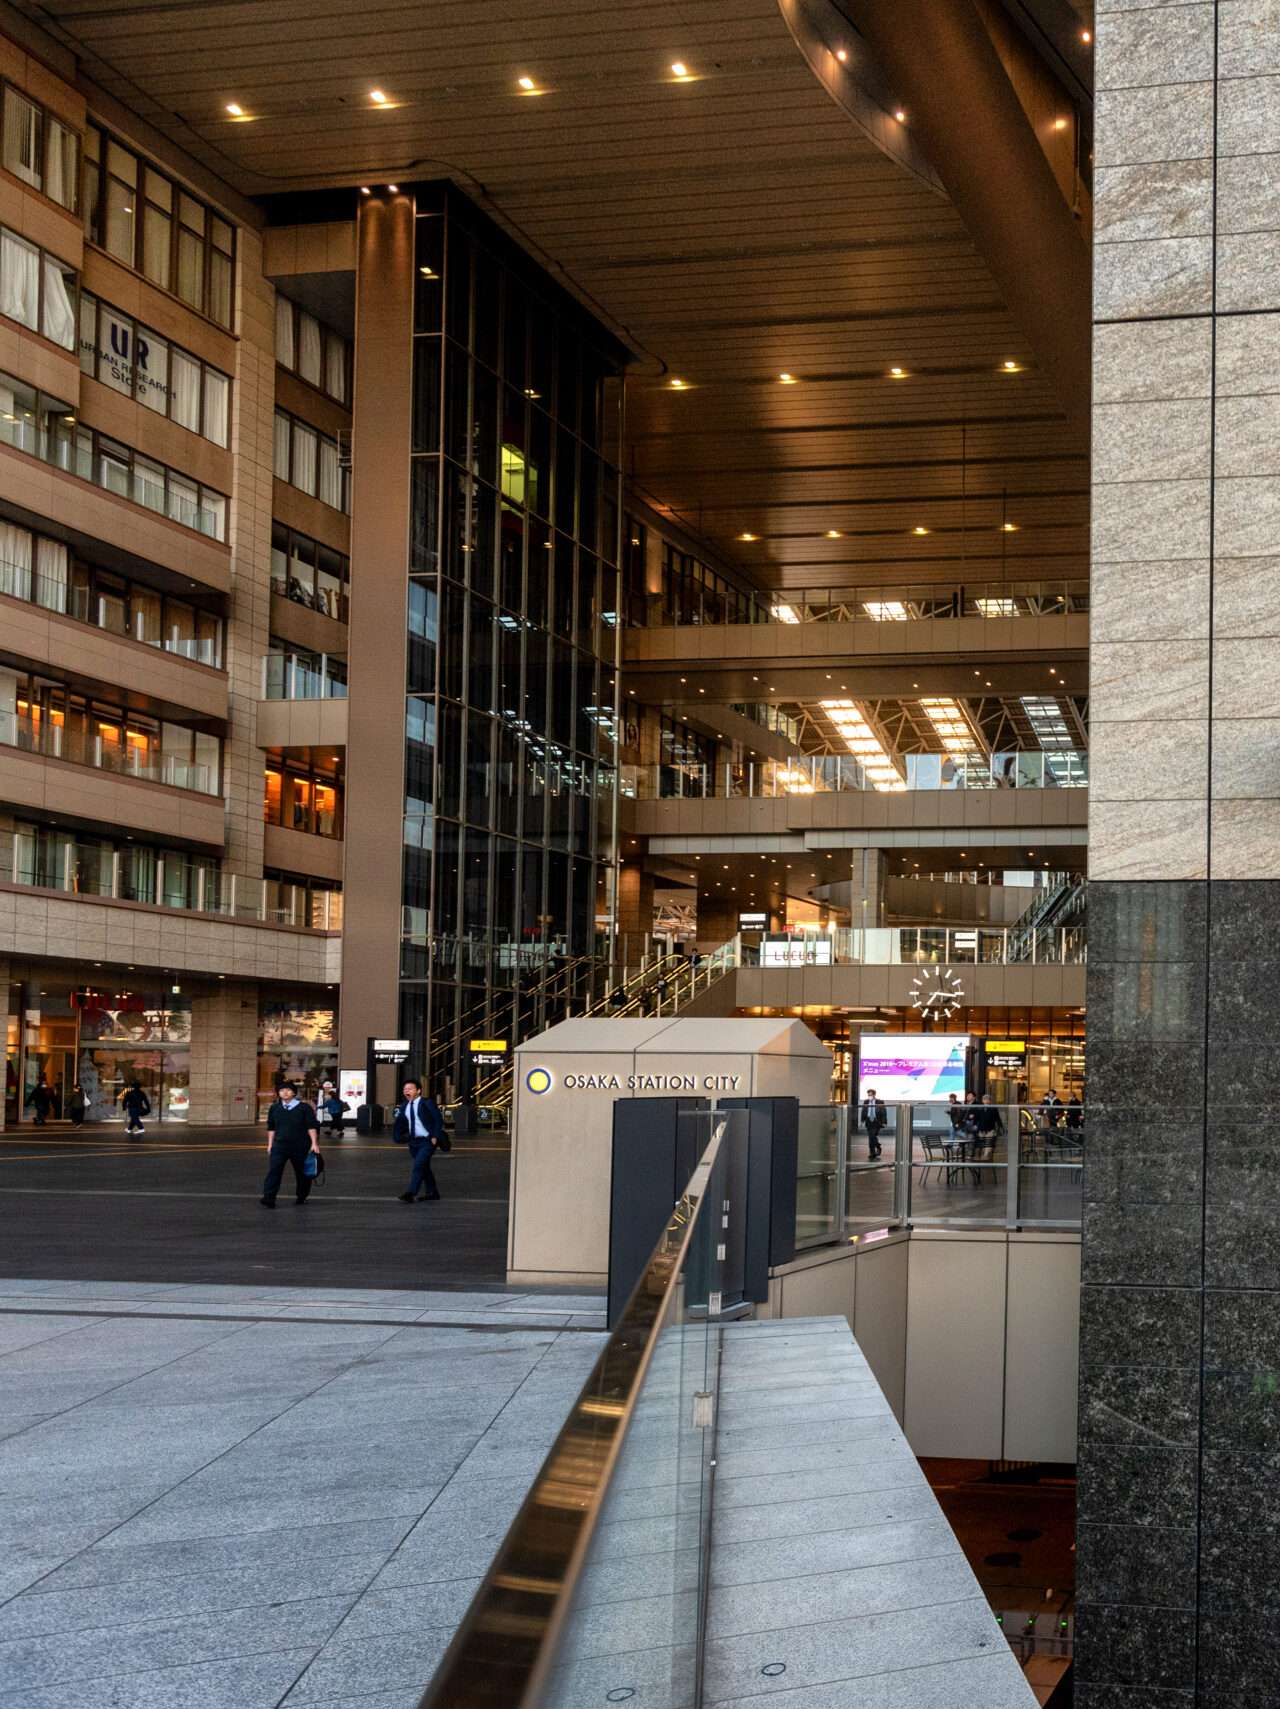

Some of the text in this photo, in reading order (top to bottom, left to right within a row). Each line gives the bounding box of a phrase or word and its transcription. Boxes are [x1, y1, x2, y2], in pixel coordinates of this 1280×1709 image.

[111, 322, 149, 370] UR
[111, 366, 147, 394] Stoe
[563, 1074, 740, 1090] OSAKA STATION CITY
